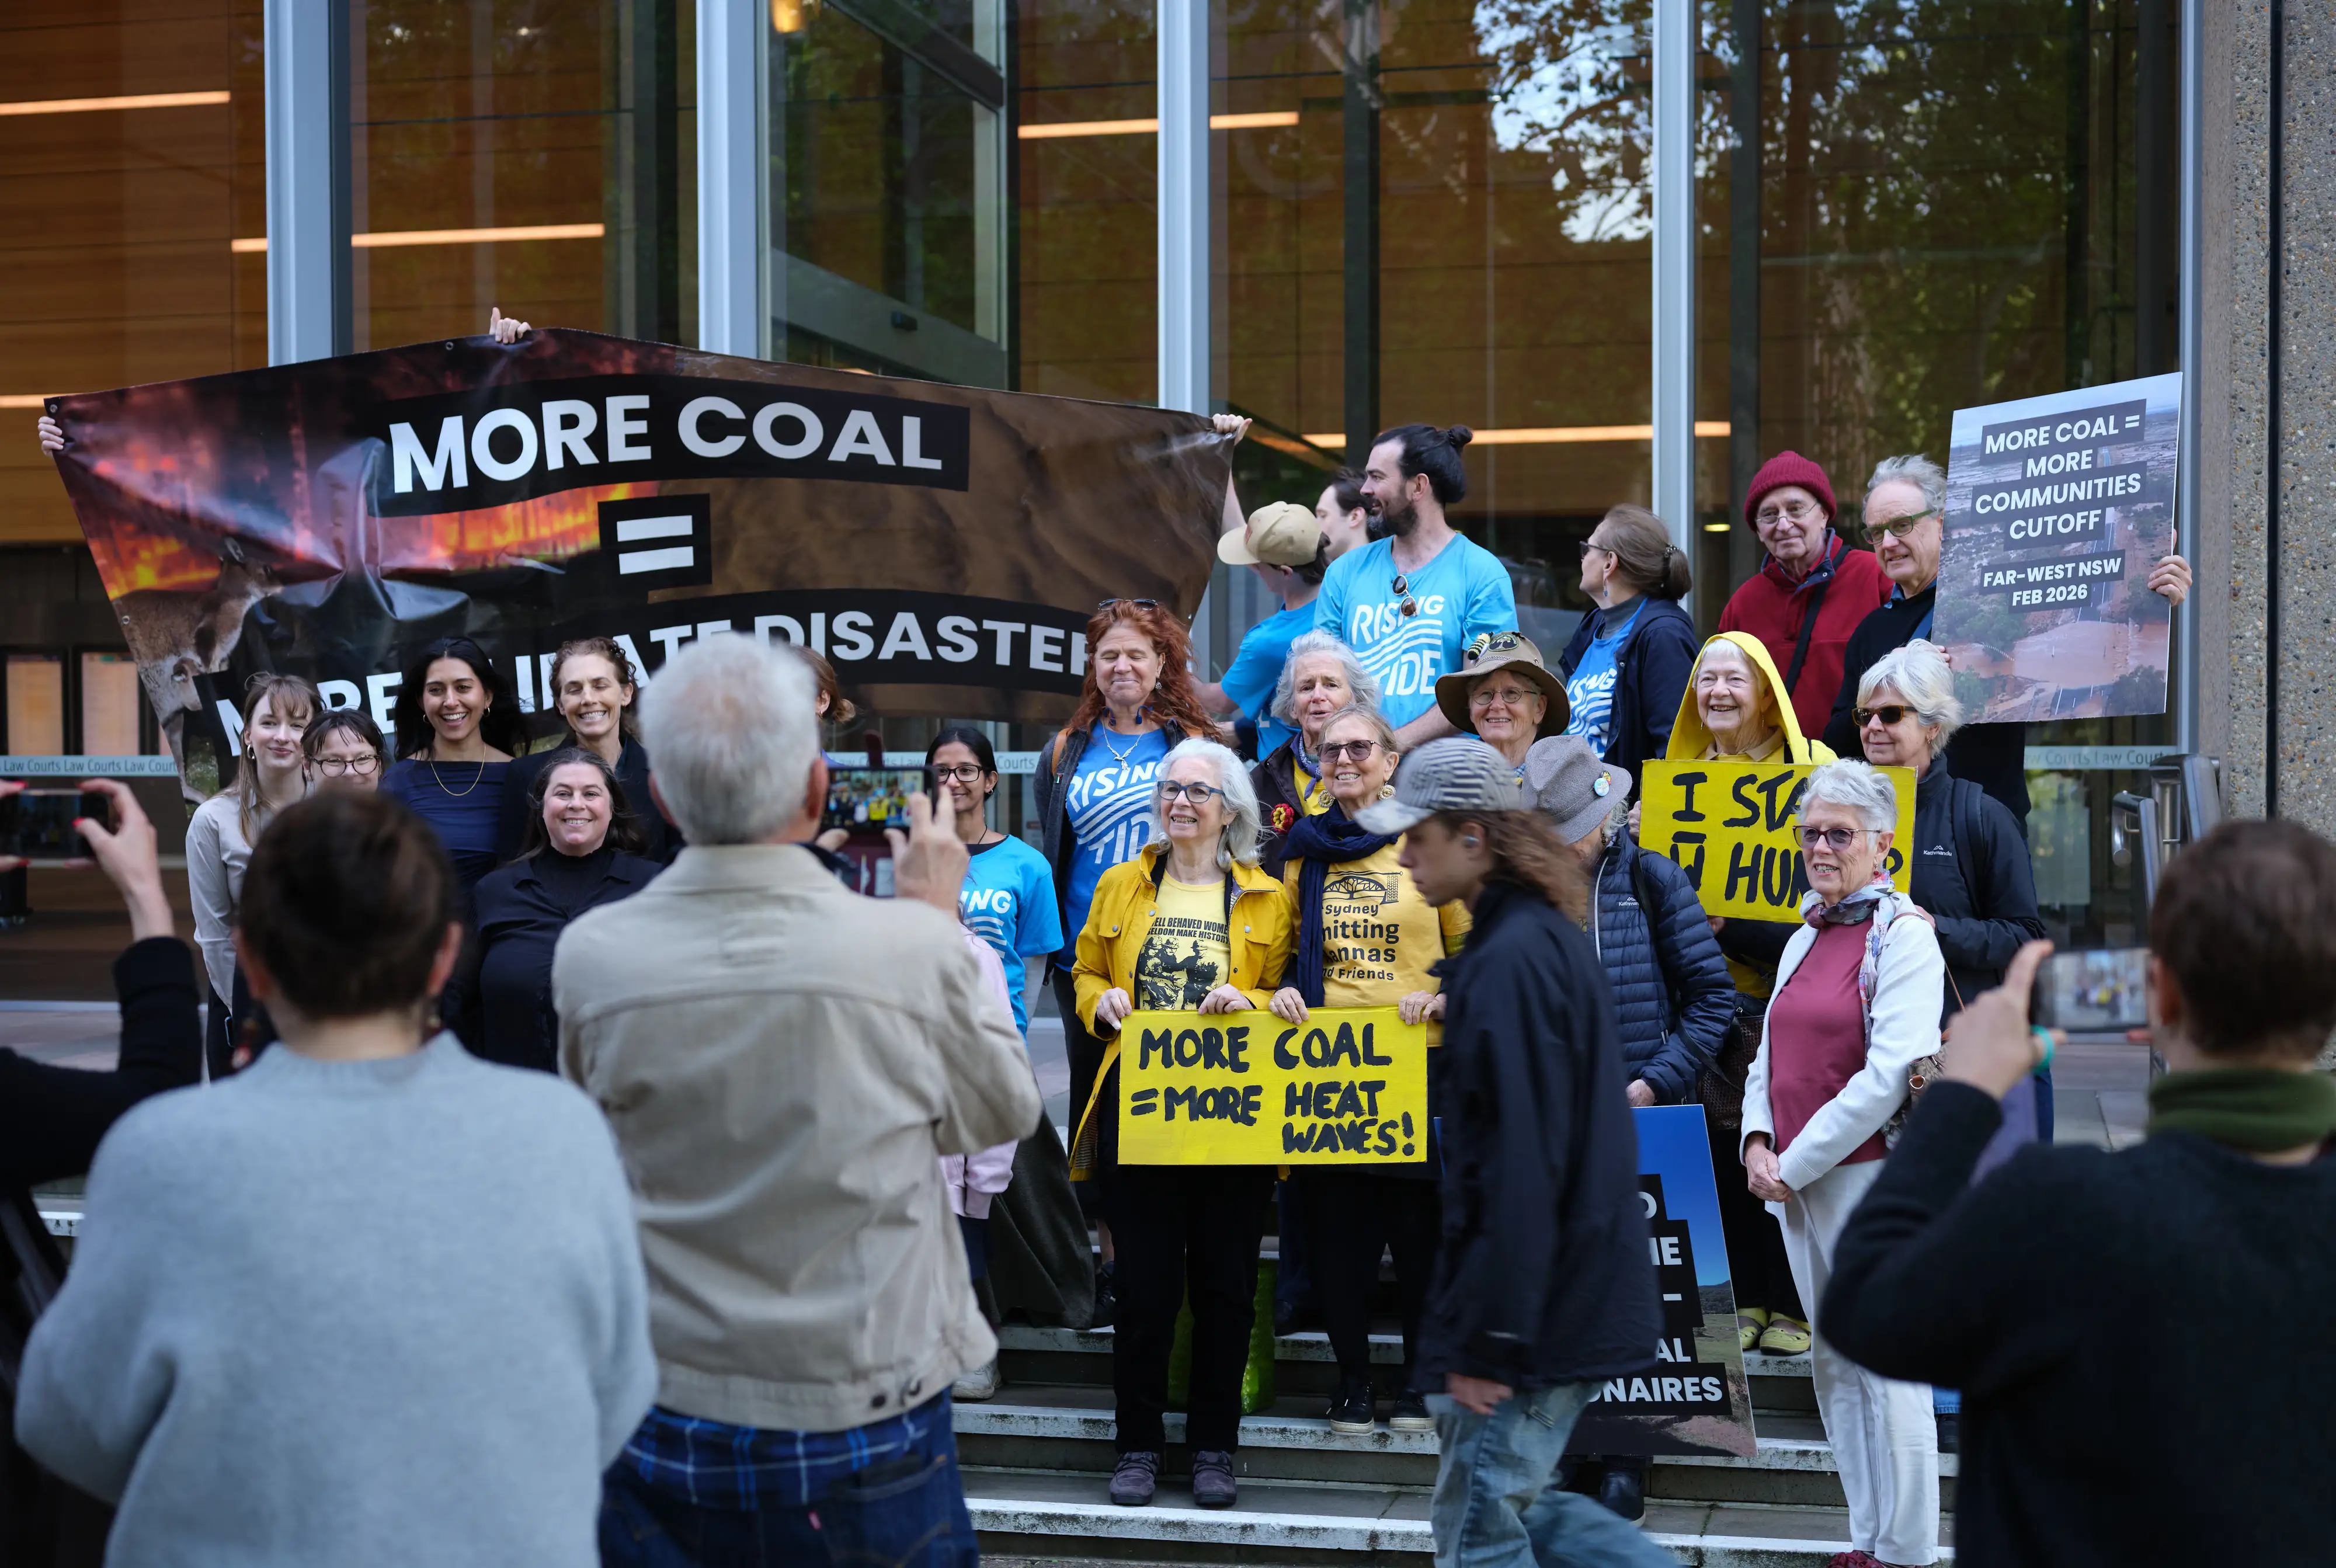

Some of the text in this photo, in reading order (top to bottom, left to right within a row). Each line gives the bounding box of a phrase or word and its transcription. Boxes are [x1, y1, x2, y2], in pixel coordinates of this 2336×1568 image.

[390, 395, 942, 493] MORE COAL
[1986, 415, 2140, 454] MORE COAL =
[2026, 449, 2092, 478] MORE
[1976, 473, 2141, 514] COMMUNITIES
[2010, 509, 2102, 540] CUTOFF
[617, 515, 694, 575] =
[1983, 557, 2122, 587] FAR-WEST NSW
[2012, 584, 2088, 606] FEB 2026
[4, 759, 24, 771] Law
[27, 759, 61, 772] Courts
[64, 759, 84, 771] Law
[88, 759, 121, 772] Courts
[124, 759, 145, 771] Law
[996, 756, 1035, 769] Courts
[1672, 771, 1708, 822] I
[1088, 812, 1155, 864] TID
[1167, 917, 1202, 929] BEHAVED
[1325, 905, 1379, 917] Sydney
[1147, 927, 1175, 936] SELDOM
[1176, 929, 1197, 938] MAKE
[1322, 919, 1400, 944] nitting
[1325, 947, 1396, 963] annas
[1339, 966, 1394, 981] Friends
[1139, 1022, 1392, 1073] MORE COAL
[1284, 1080, 1386, 1119] HEAT
[1282, 1111, 1416, 1157] WAVES!
